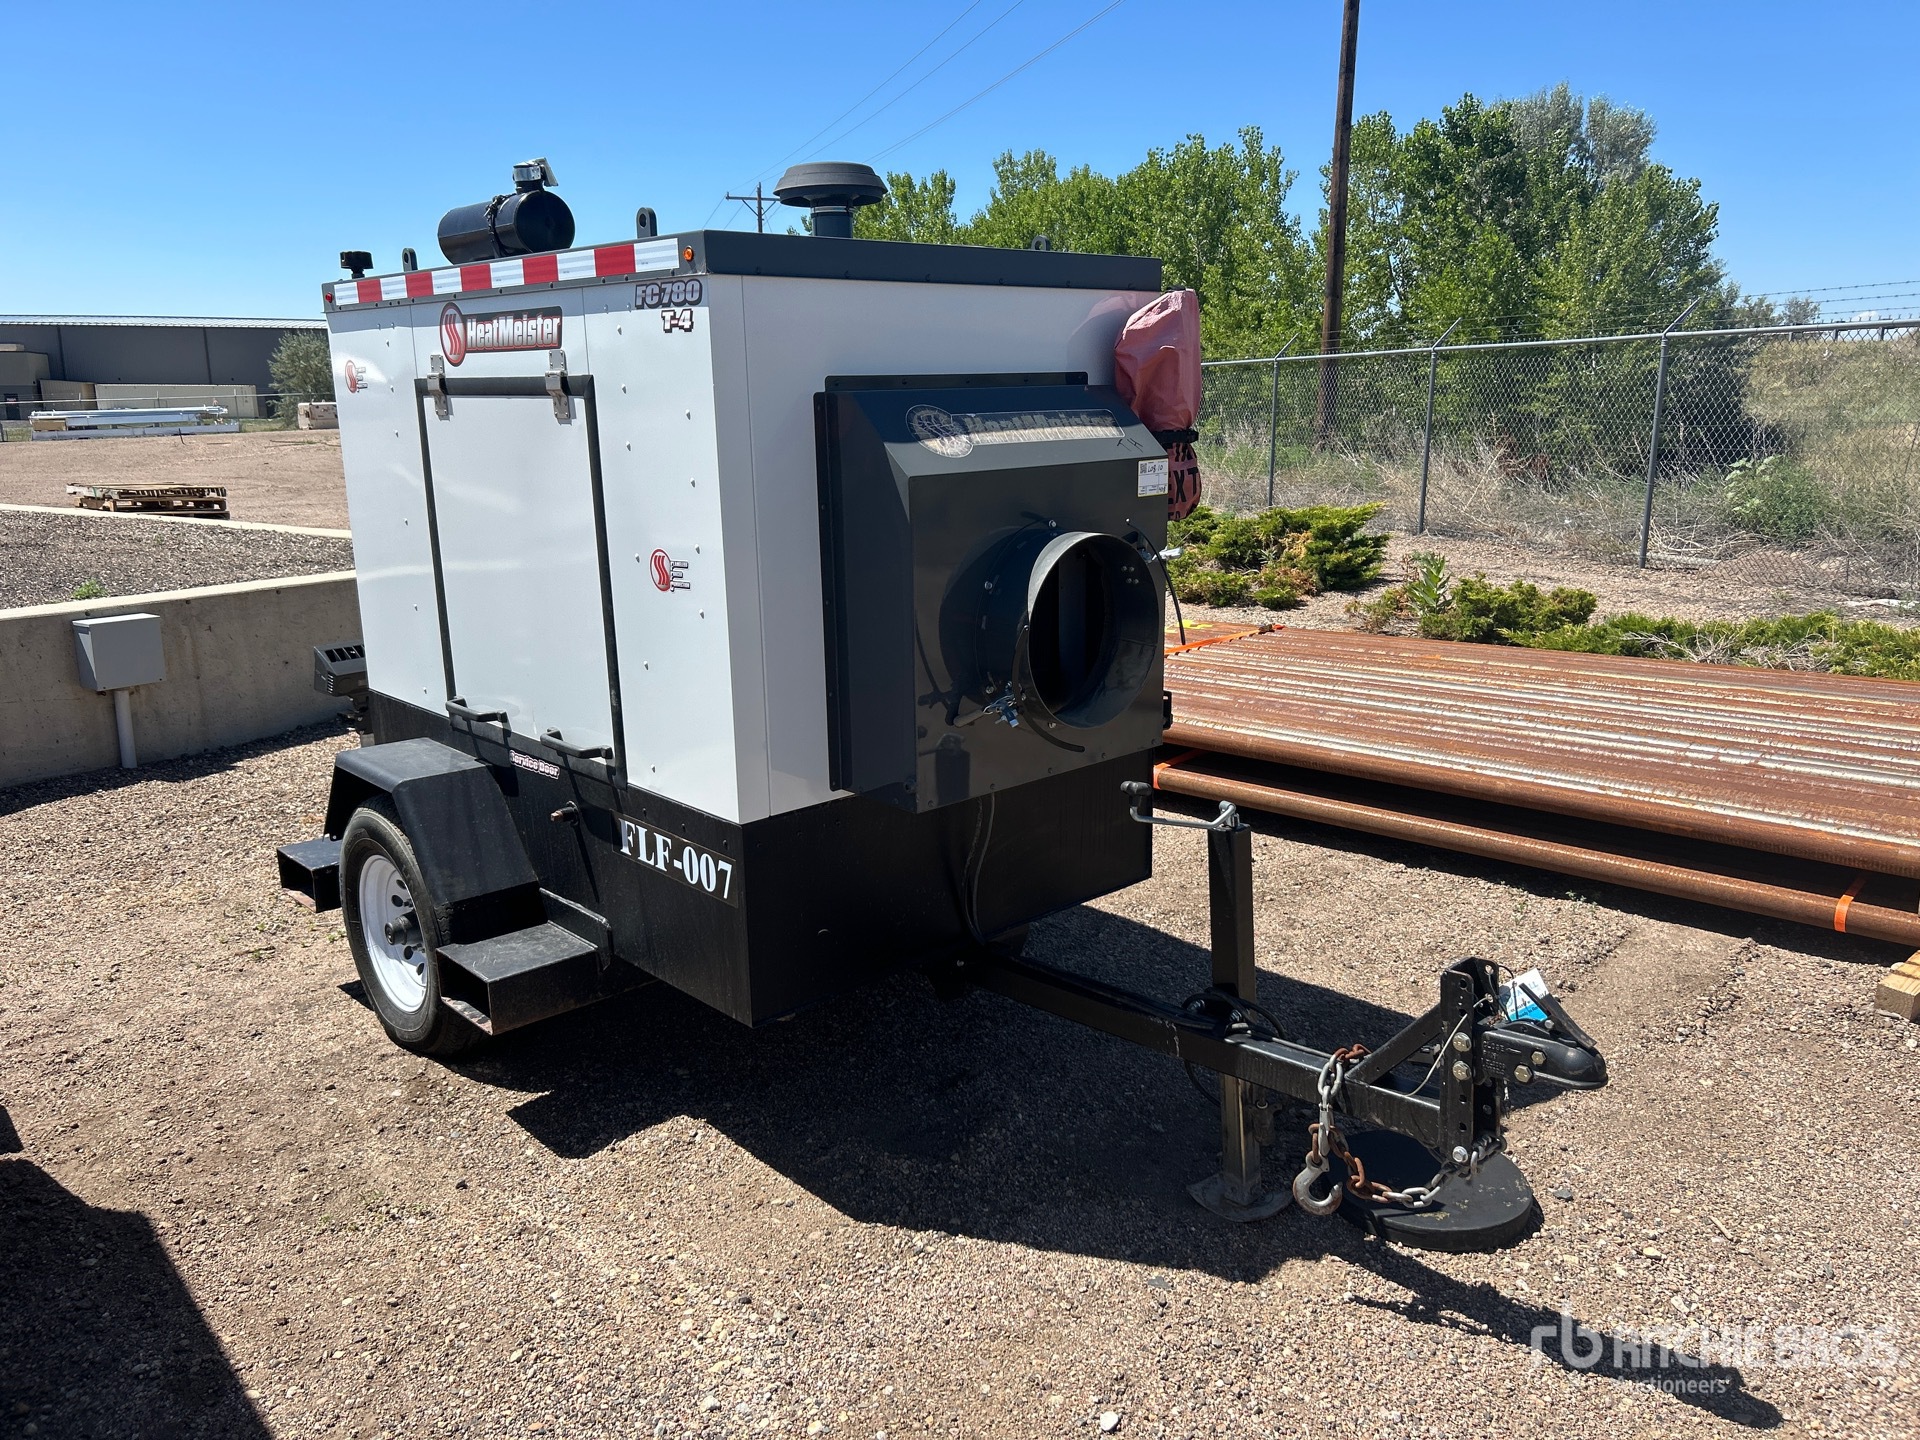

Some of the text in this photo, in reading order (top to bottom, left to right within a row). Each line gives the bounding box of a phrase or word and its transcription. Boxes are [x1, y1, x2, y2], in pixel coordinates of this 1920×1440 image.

[634, 278, 703, 310] FC780
[466, 313, 562, 351] HeatMeister
[661, 308, 694, 334] T-4
[510, 750, 560, 779] Service Door
[618, 817, 734, 900] FLF-007
